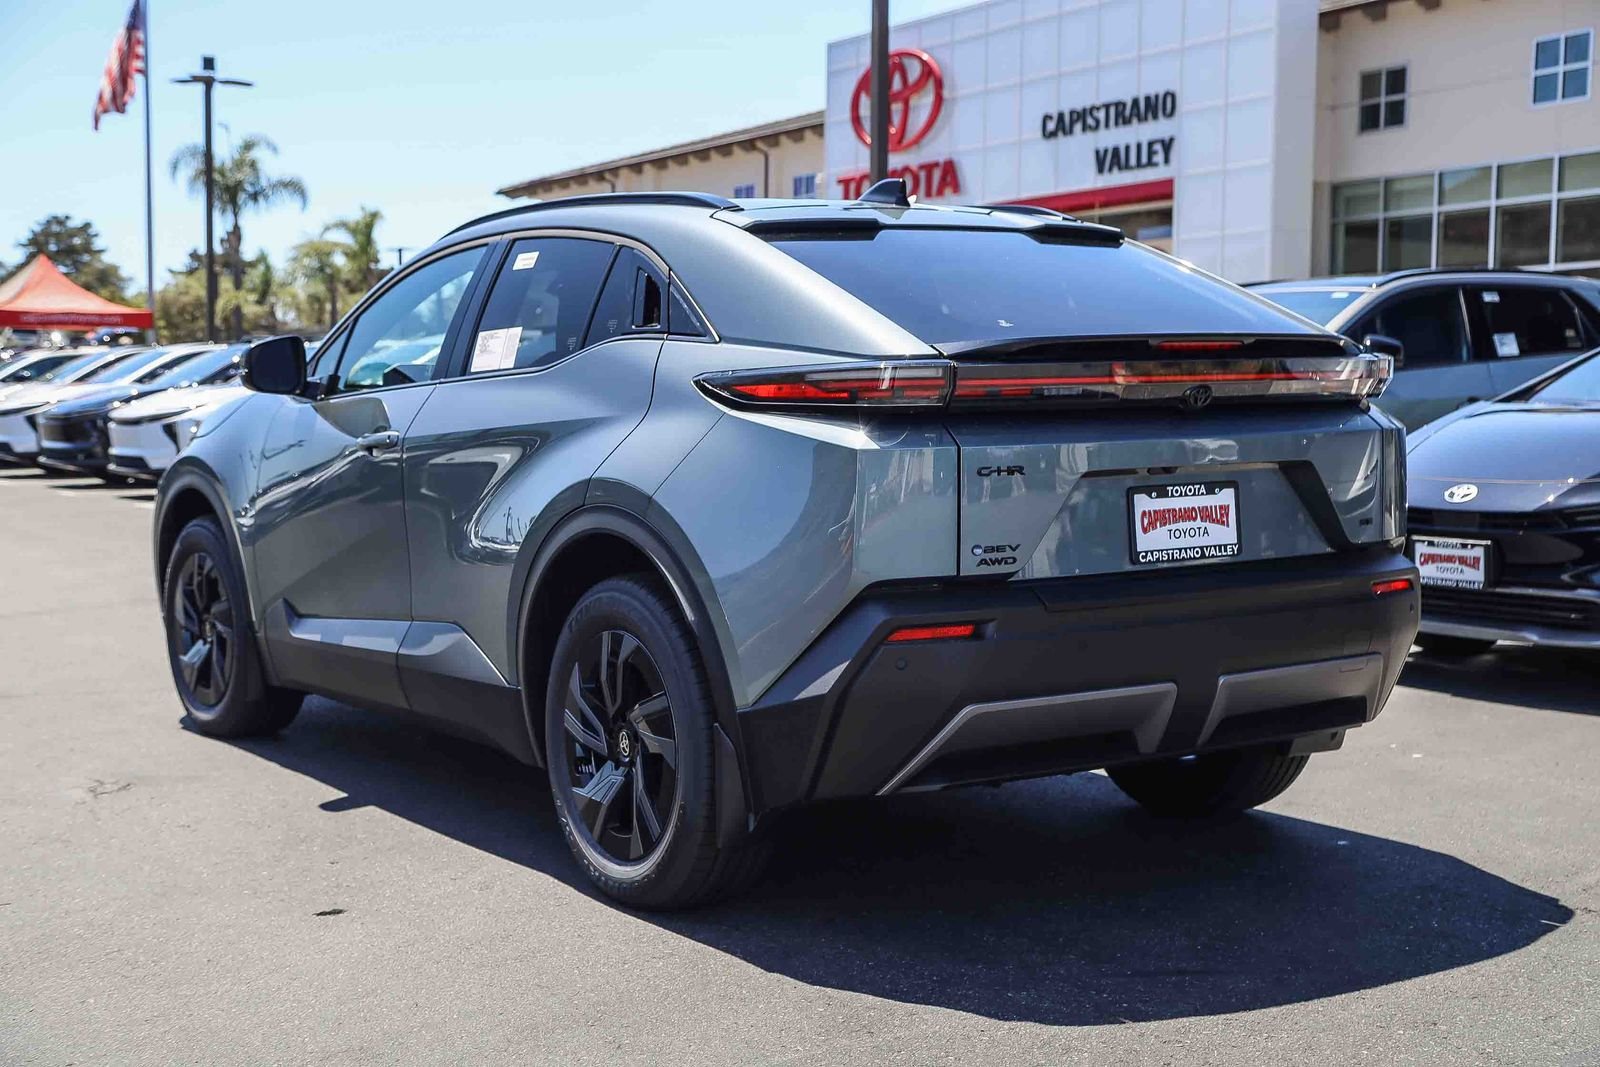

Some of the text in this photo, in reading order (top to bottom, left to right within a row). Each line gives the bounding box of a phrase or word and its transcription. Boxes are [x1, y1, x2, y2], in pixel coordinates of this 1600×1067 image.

[1042, 90, 1176, 139] CAPISTRANO
[1095, 136, 1175, 174] VALLEY
[836, 157, 961, 201] TOTA
[1166, 484, 1207, 497] TOYOTA
[1140, 504, 1231, 535] CAPISTRANO VALLEY
[1167, 526, 1210, 540] TOYOTA
[983, 543, 1022, 554] BEV
[1139, 544, 1239, 563] CAPISTRANO VALLEY
[976, 556, 1018, 567] AWD
[1436, 566, 1464, 575] TOYOTA
